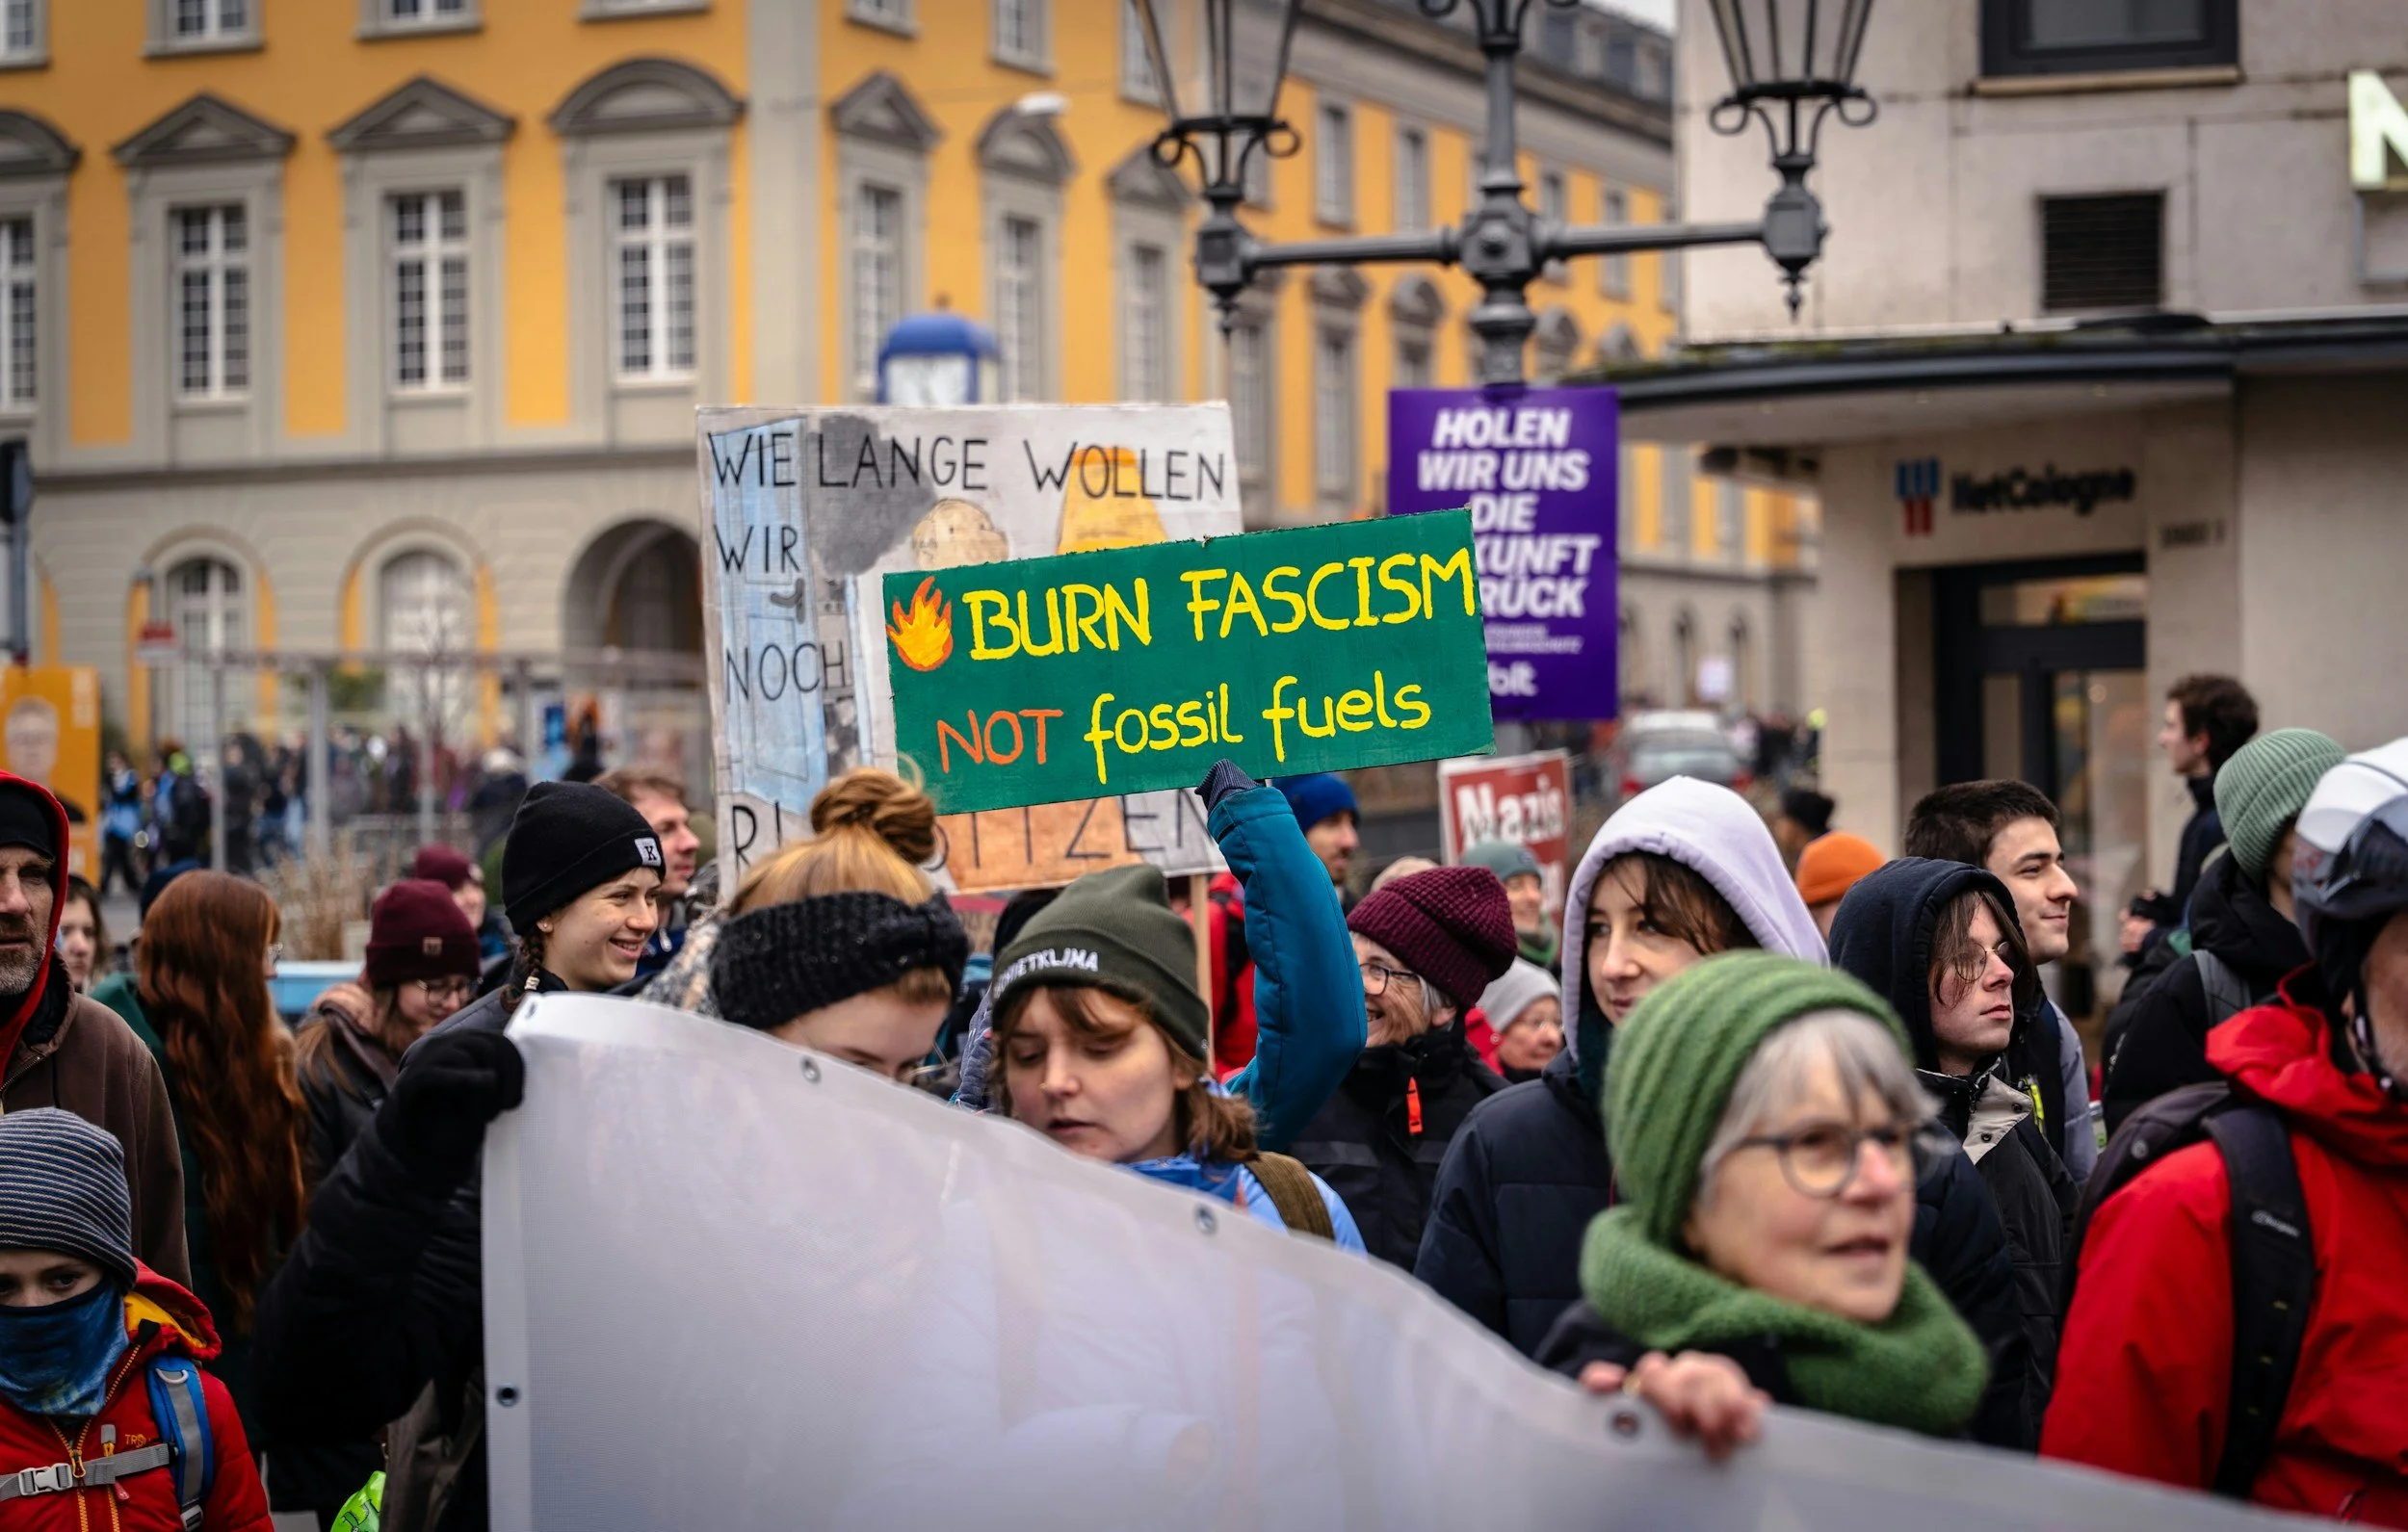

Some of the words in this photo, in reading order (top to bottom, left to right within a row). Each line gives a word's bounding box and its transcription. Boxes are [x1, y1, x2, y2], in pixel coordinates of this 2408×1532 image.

[1431, 407, 1572, 449] HOLEN
[707, 431, 798, 488] WIE
[818, 433, 988, 489] LANGE
[1022, 438, 1225, 501] WOLLEN
[1417, 451, 1499, 491] WIR
[1500, 450, 1590, 491] UNS
[1471, 491, 1538, 532] DIE
[713, 523, 801, 573] WIR
[962, 577, 1152, 661] BURN
[1180, 547, 1476, 642] FASCISM
[725, 640, 846, 705] NOCH
[937, 709, 1064, 773] NOT
[1084, 683, 1244, 785] fossil
[1262, 670, 1432, 764] fuels
[1455, 773, 1563, 849] Nazis
[643, 845, 657, 861] K
